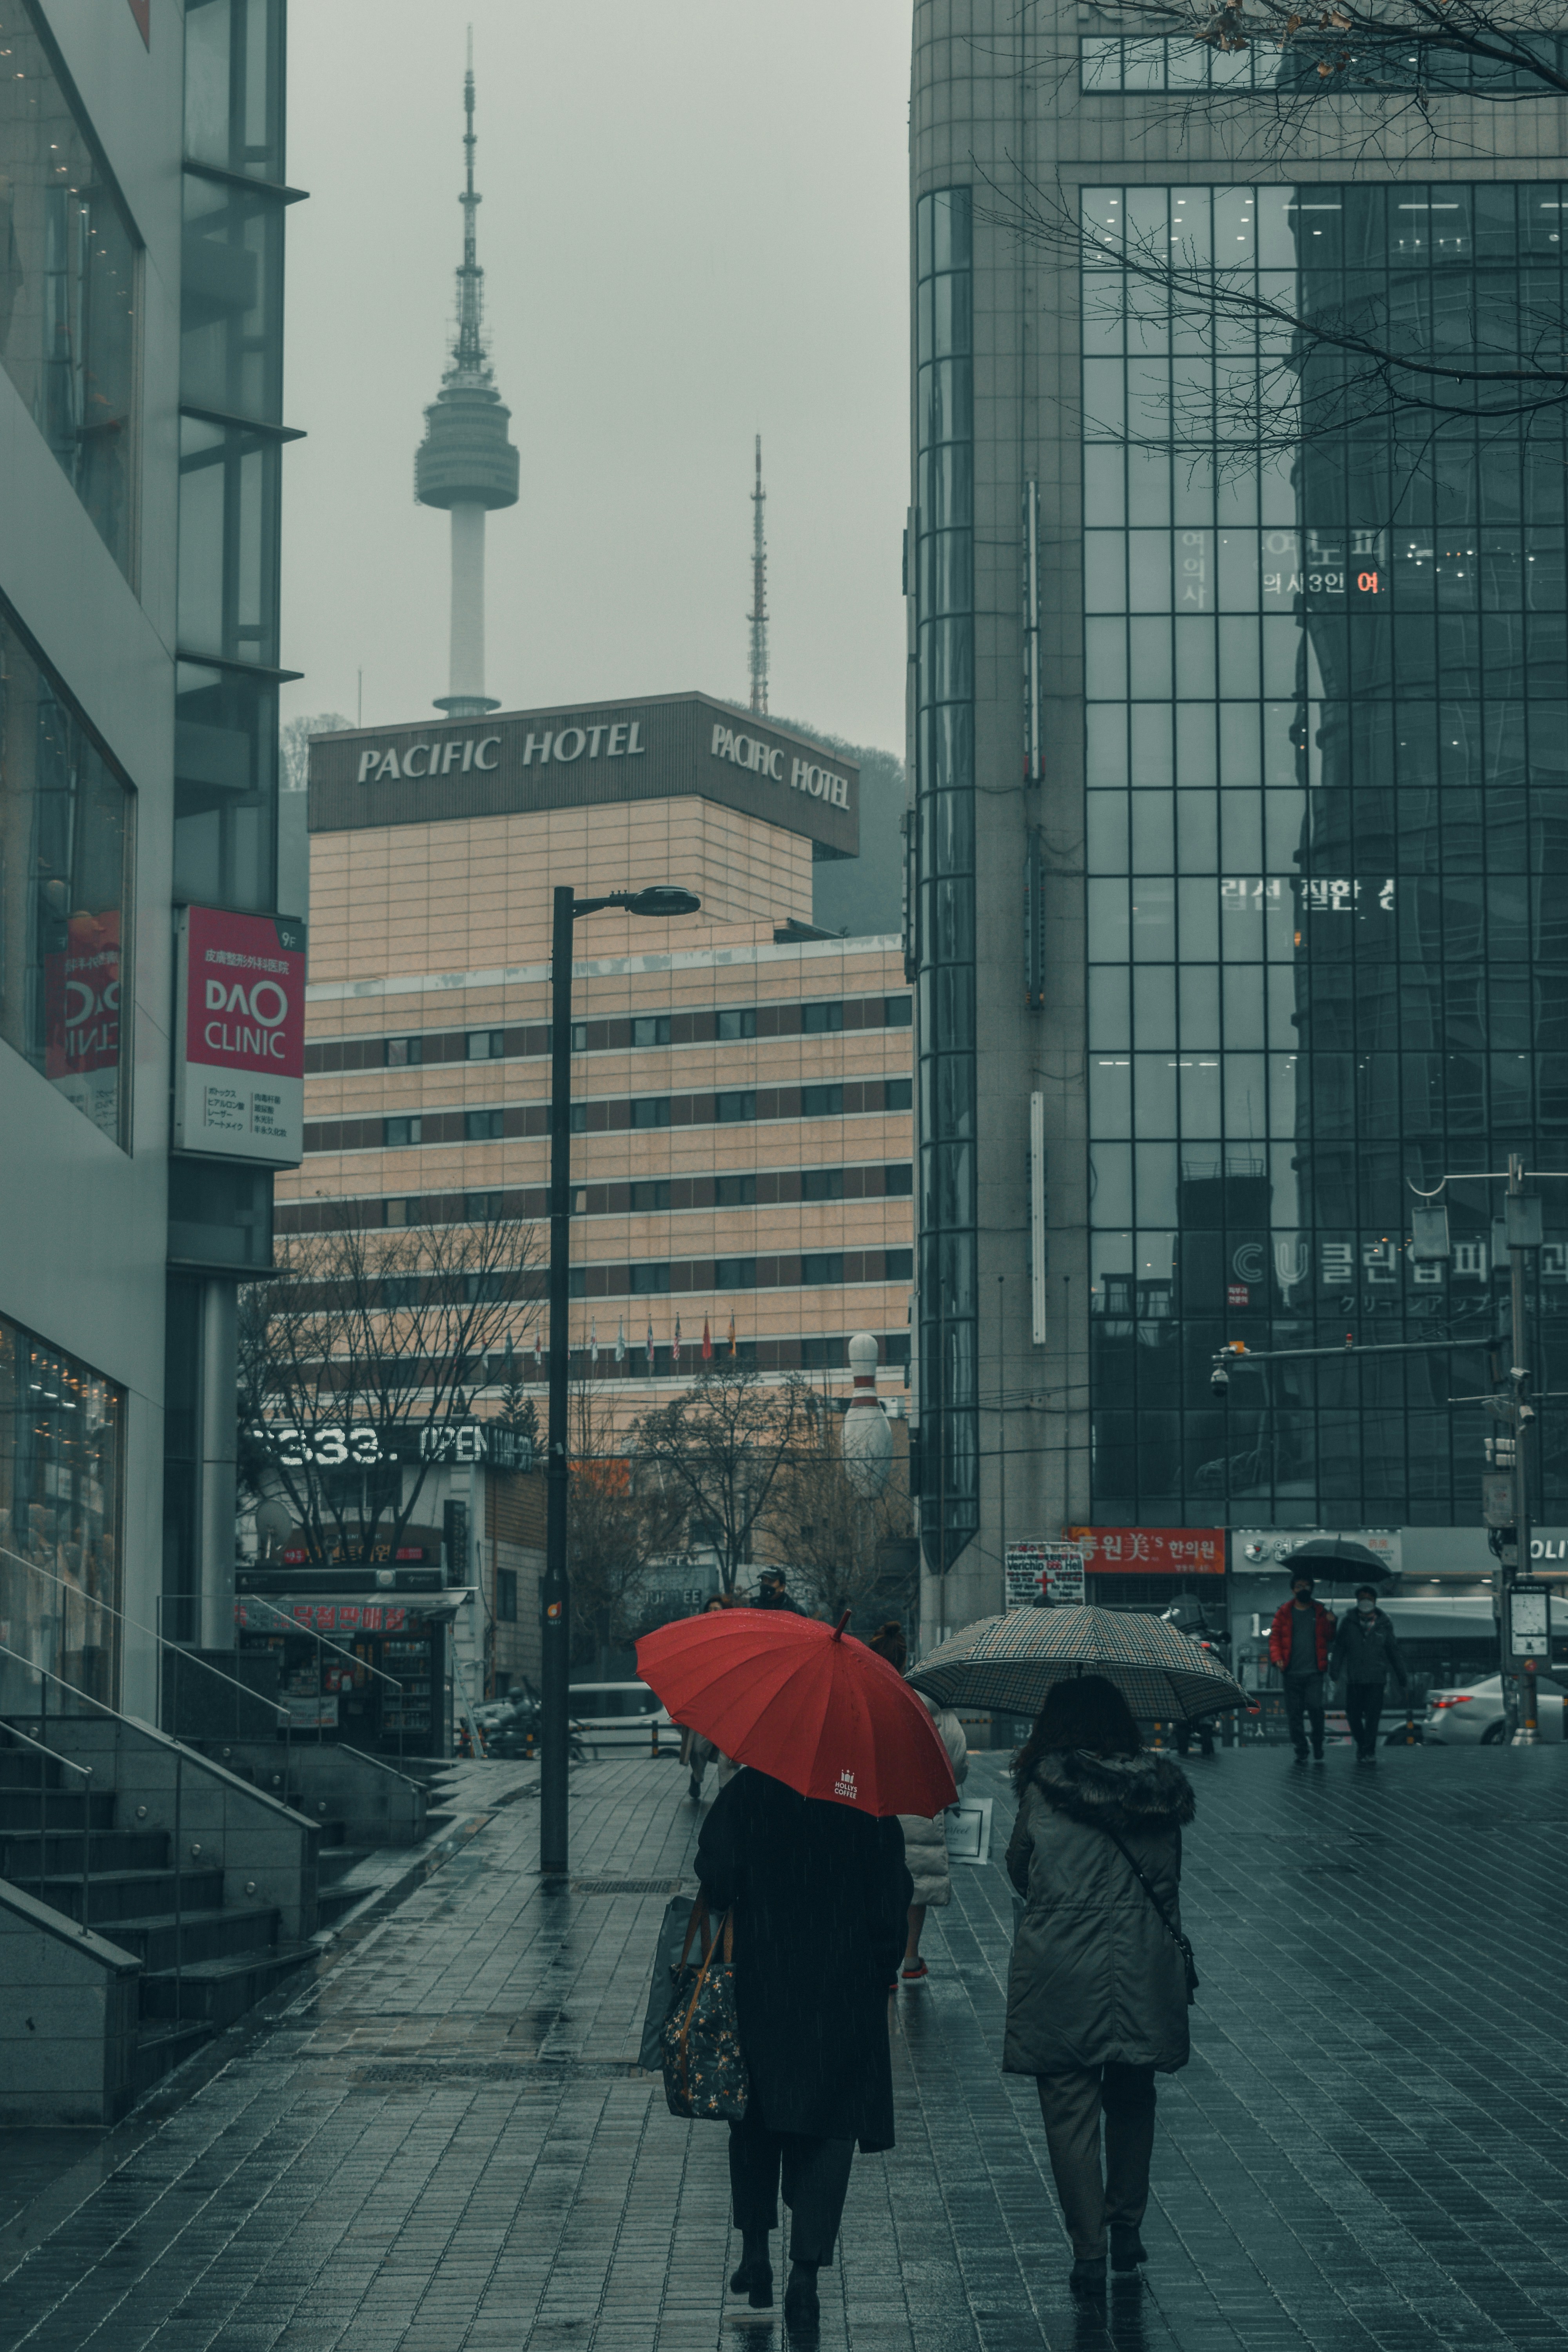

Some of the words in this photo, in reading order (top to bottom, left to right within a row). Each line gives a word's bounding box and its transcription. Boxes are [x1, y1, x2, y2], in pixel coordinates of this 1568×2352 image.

[357, 735, 501, 783] PACIFIC
[523, 722, 644, 766] HOTEL
[711, 723, 785, 781] PACIFIC
[791, 757, 850, 811] HOTEL
[1301, 879, 1361, 910] 질환
[281, 932, 296, 947] 9F
[205, 948, 290, 975] 皮膚整形外科医院
[206, 980, 288, 1027] DAO
[205, 1022, 285, 1058] CLINIC
[419, 1426, 487, 1462] OPEN
[1169, 1540, 1215, 1559] 한의원
[1007, 1560, 1044, 1570] Verichip
[293, 1605, 405, 1631] 당첨판매점
[834, 1788, 857, 1799] COFFEE
[835, 1781, 858, 1793] HOLLYS
